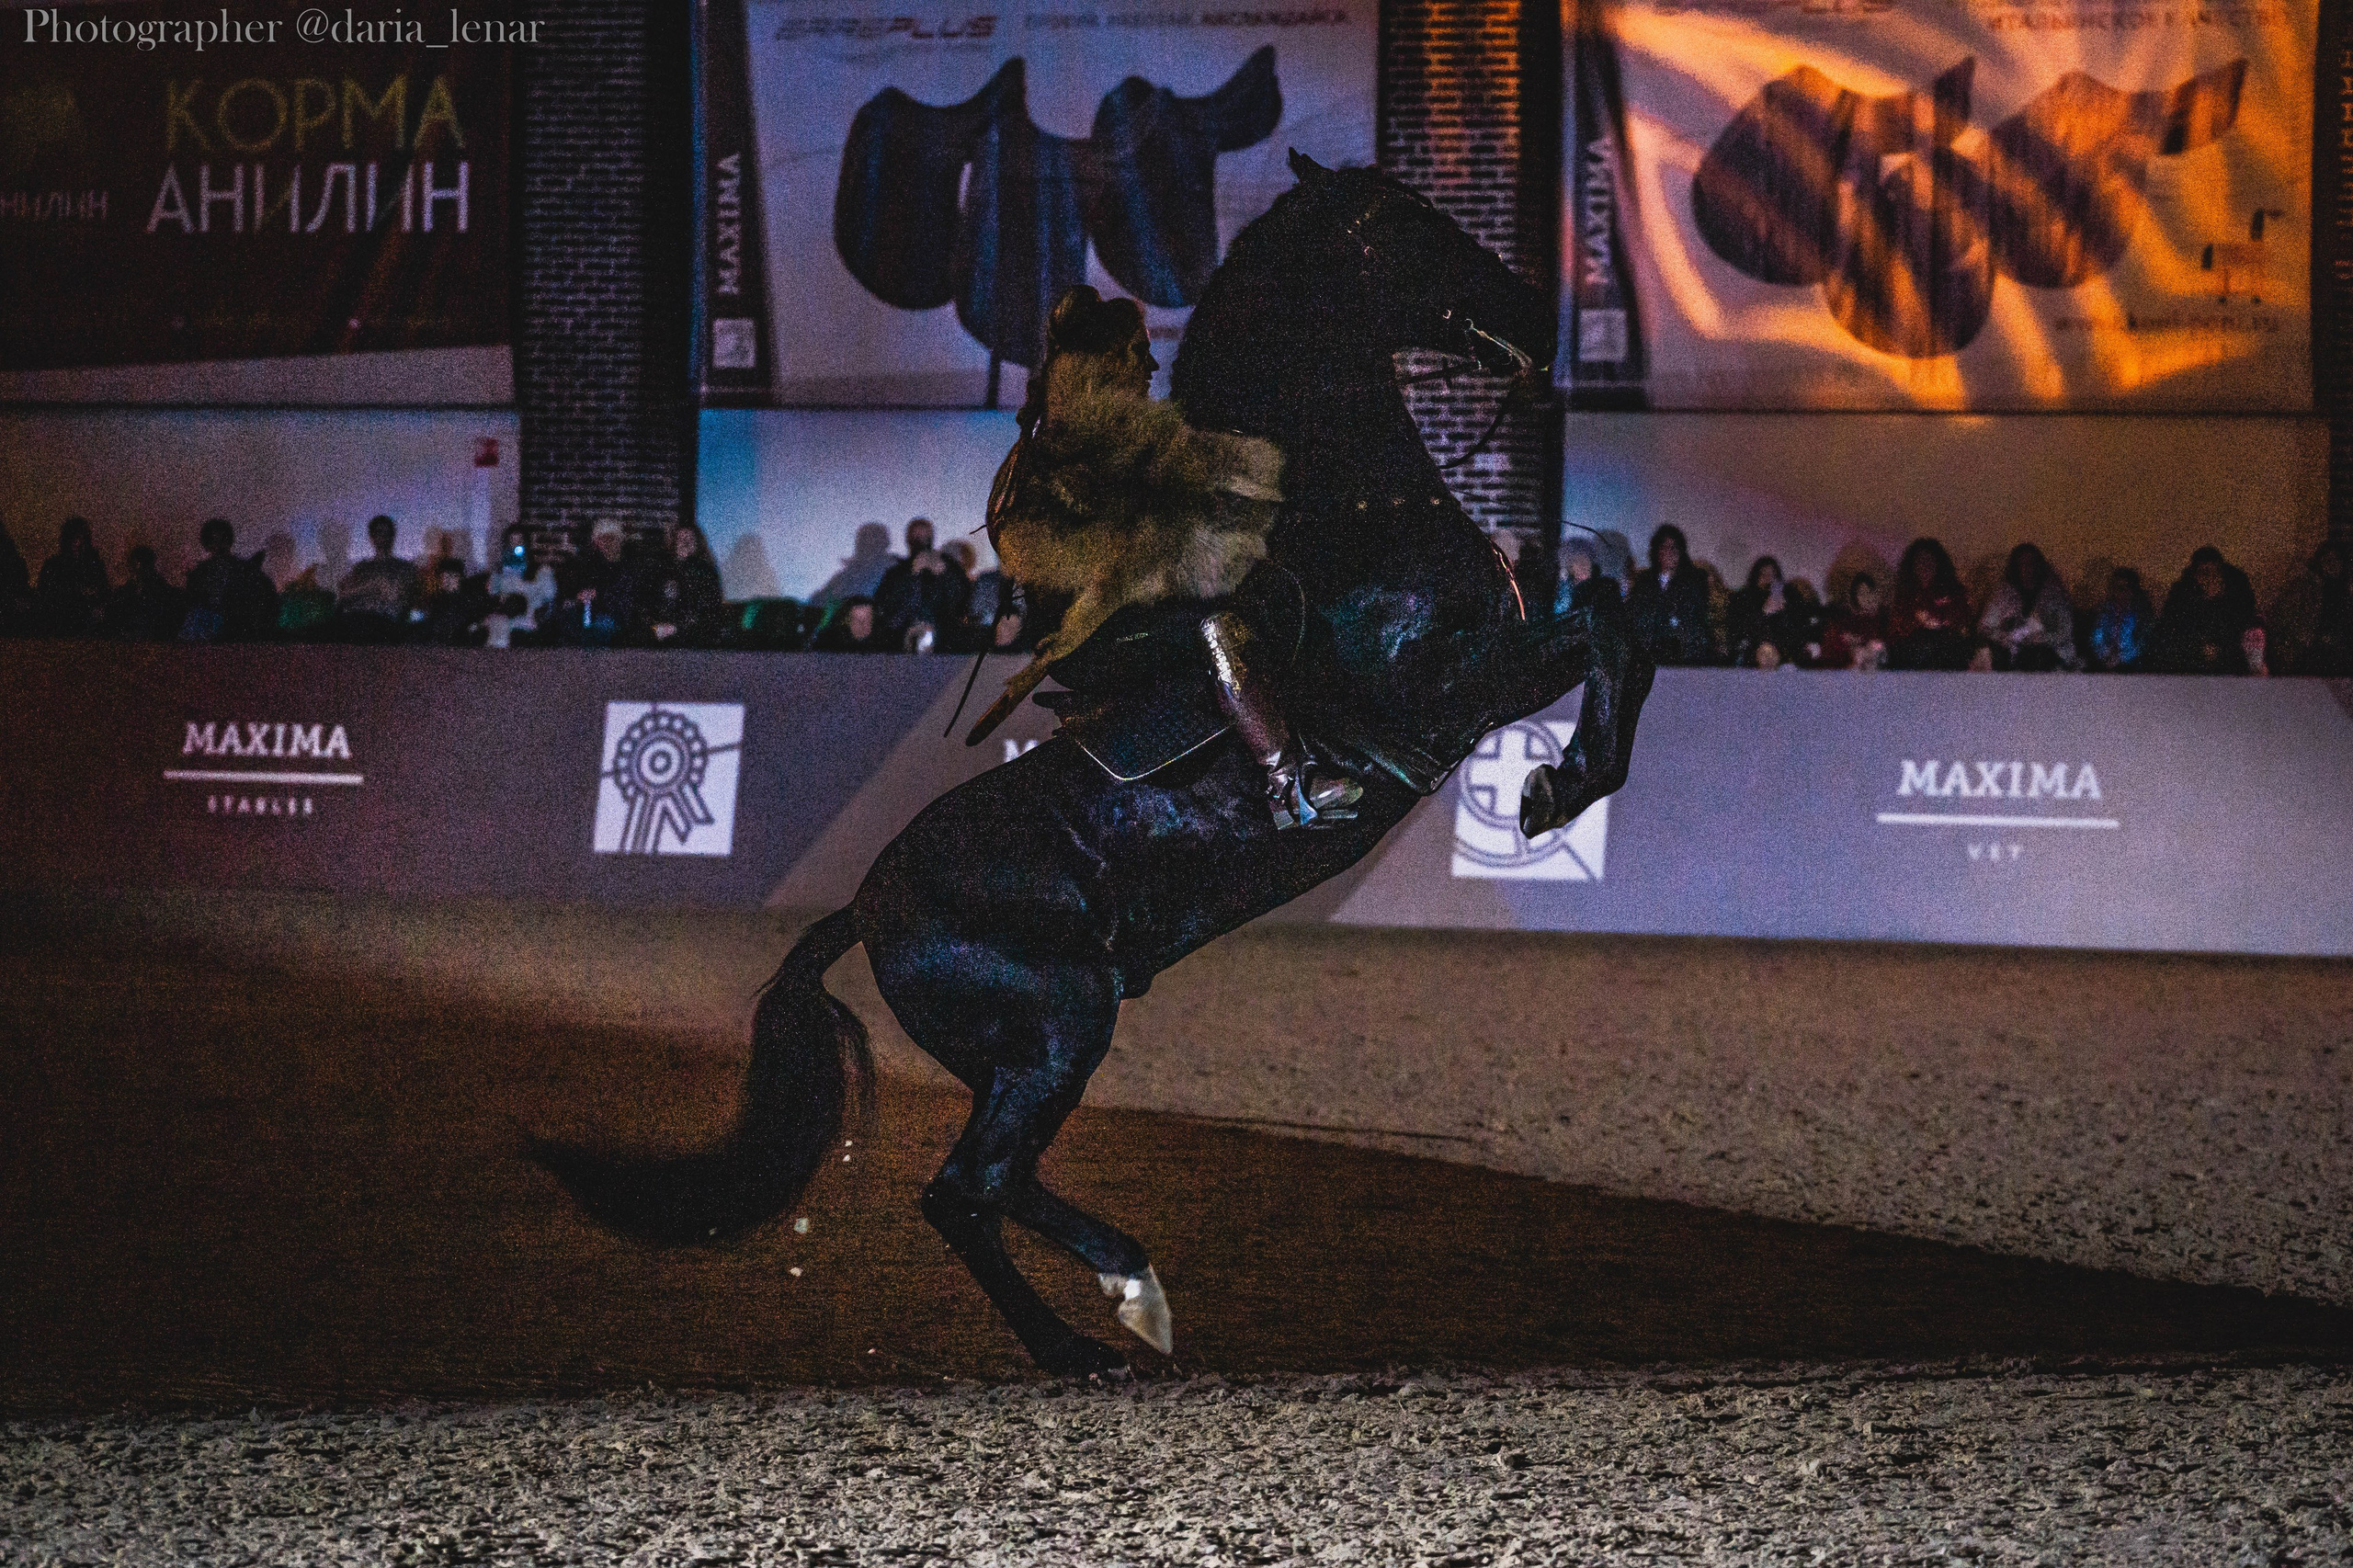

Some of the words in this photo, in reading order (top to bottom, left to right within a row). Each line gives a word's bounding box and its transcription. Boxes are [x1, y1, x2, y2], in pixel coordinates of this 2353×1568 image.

[165, 74, 464, 153] КОРМА
[146, 160, 472, 234] АНИЛИН
[716, 153, 742, 296] MAXIMA
[1585, 137, 1614, 287] MAXIMA
[182, 720, 351, 758] MAXIMA
[1897, 759, 2101, 798] MAXIMA
